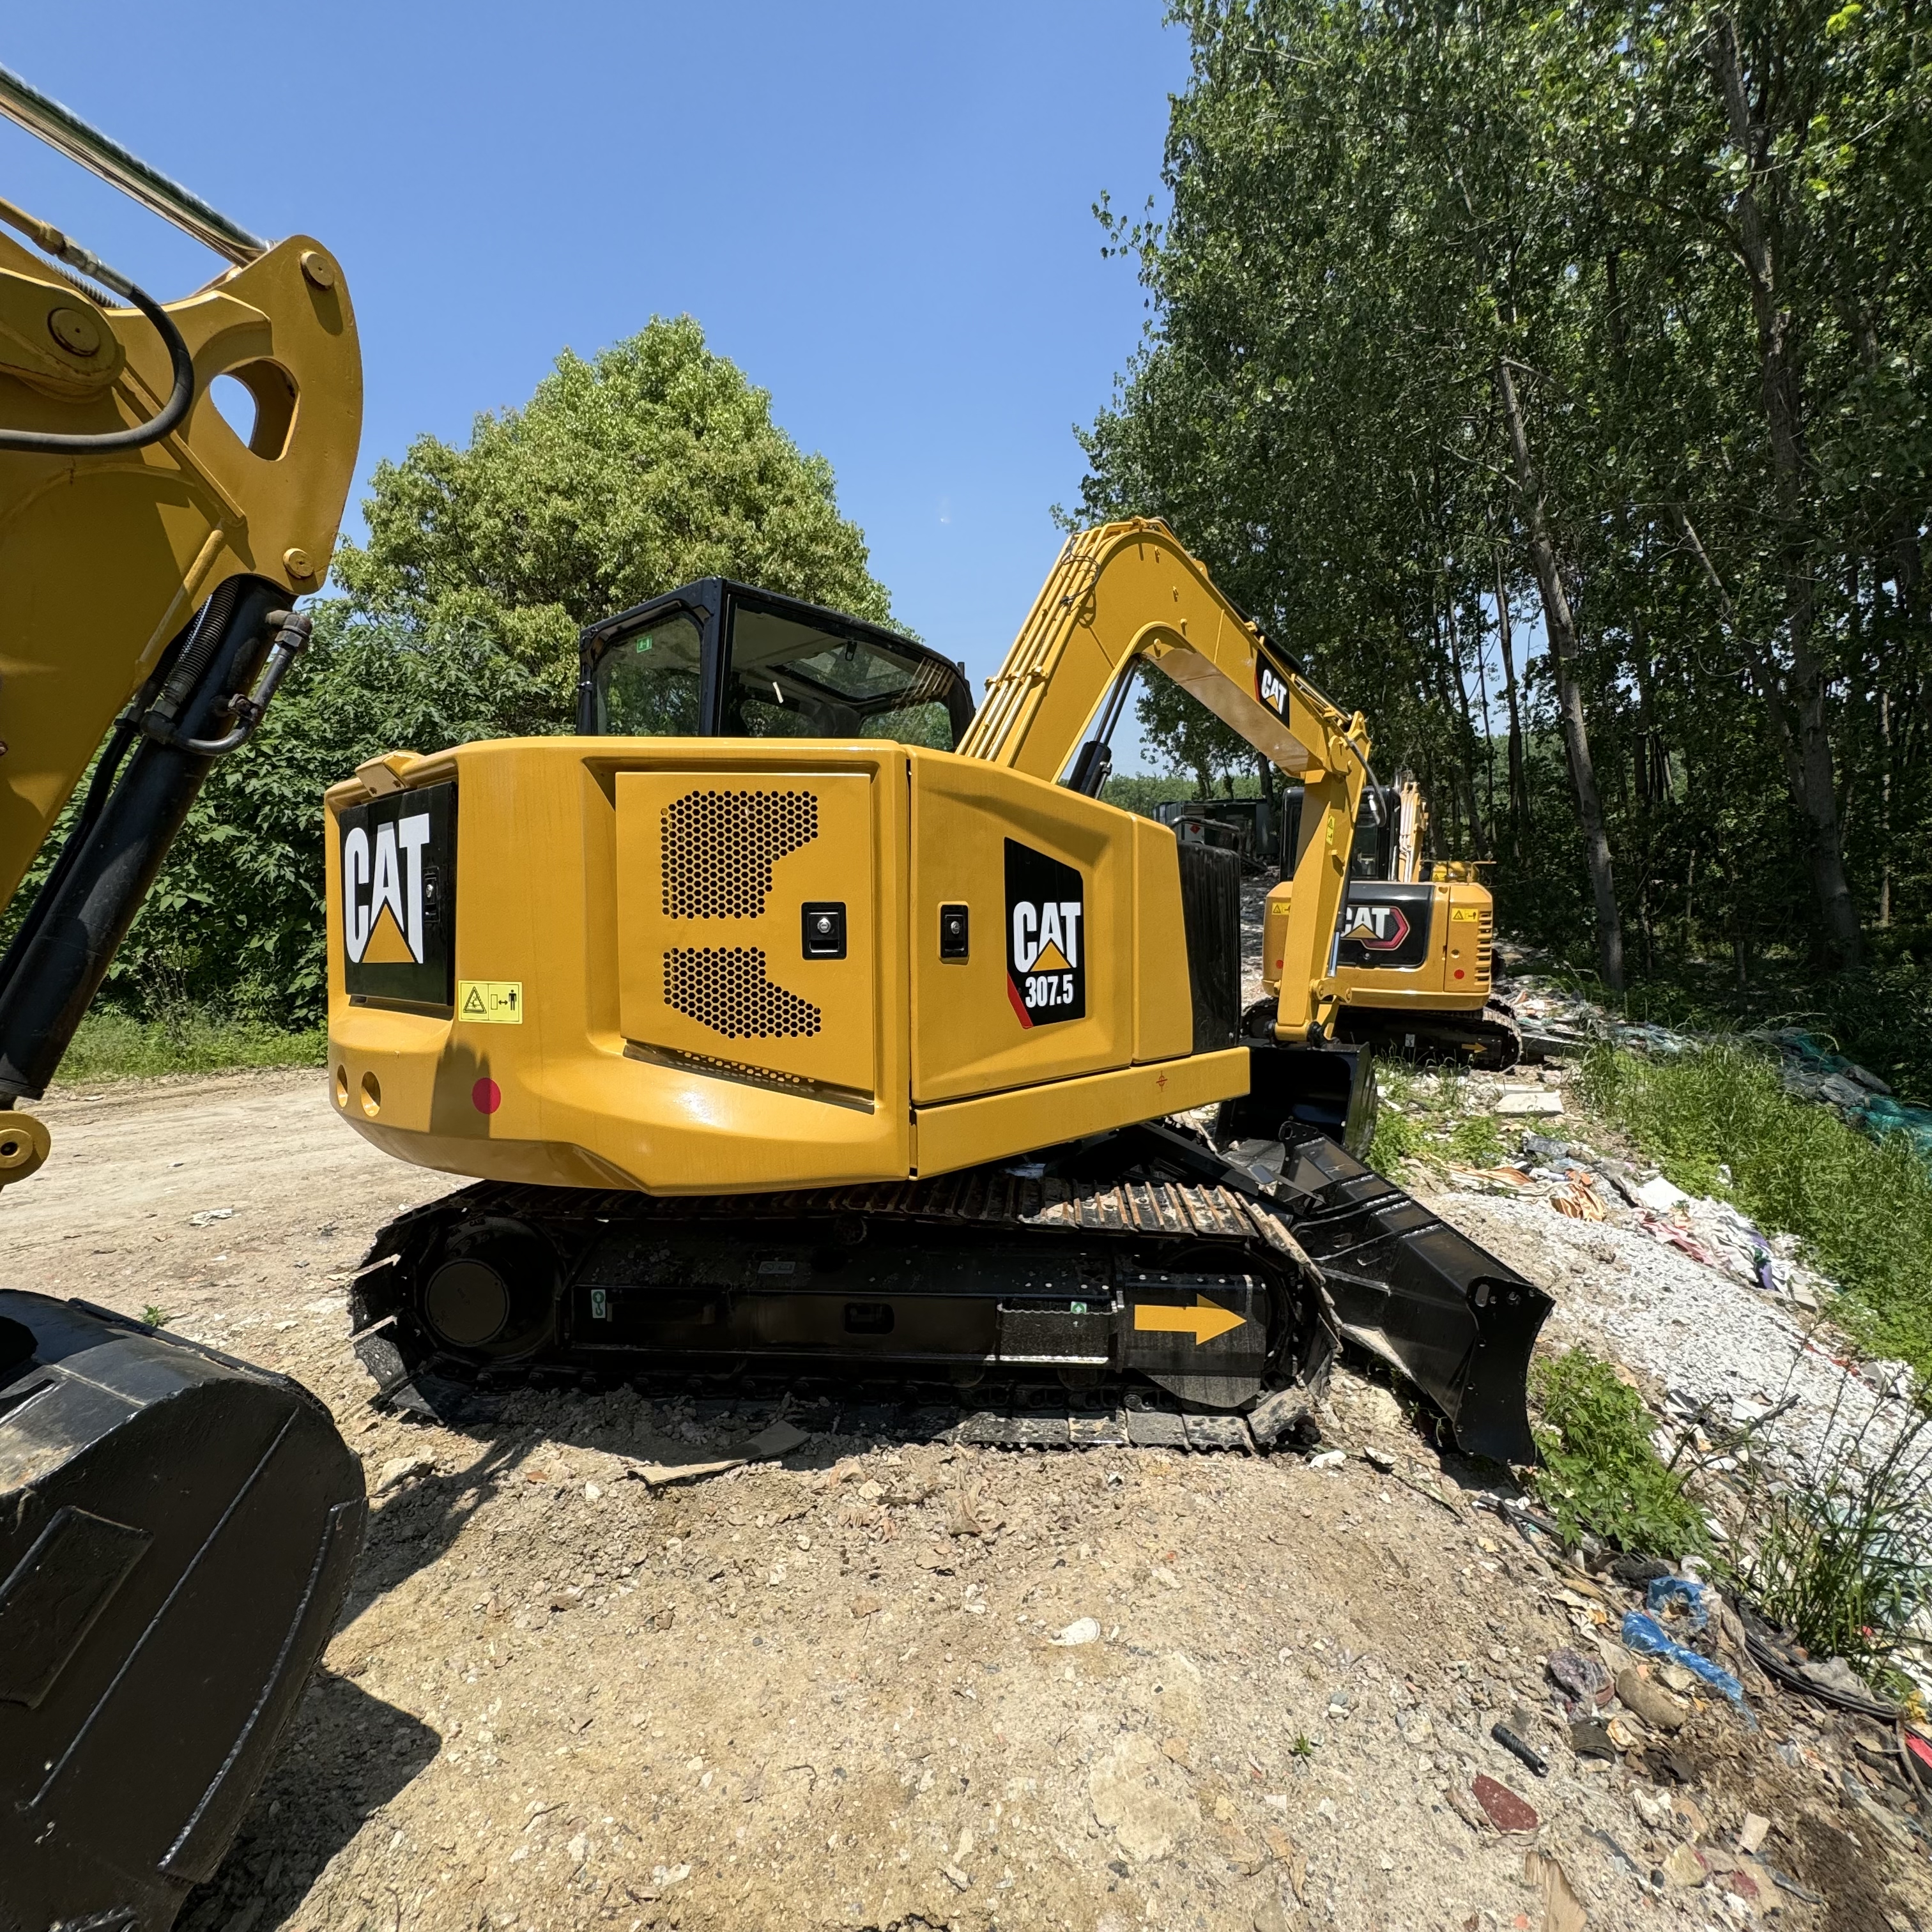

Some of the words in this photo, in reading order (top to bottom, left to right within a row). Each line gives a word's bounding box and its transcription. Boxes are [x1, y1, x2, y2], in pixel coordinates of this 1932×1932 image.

[1261, 669, 1287, 715] CAT
[345, 813, 429, 964] CAT
[1013, 901, 1081, 973] CAT
[1025, 974, 1073, 1008] 307.5
